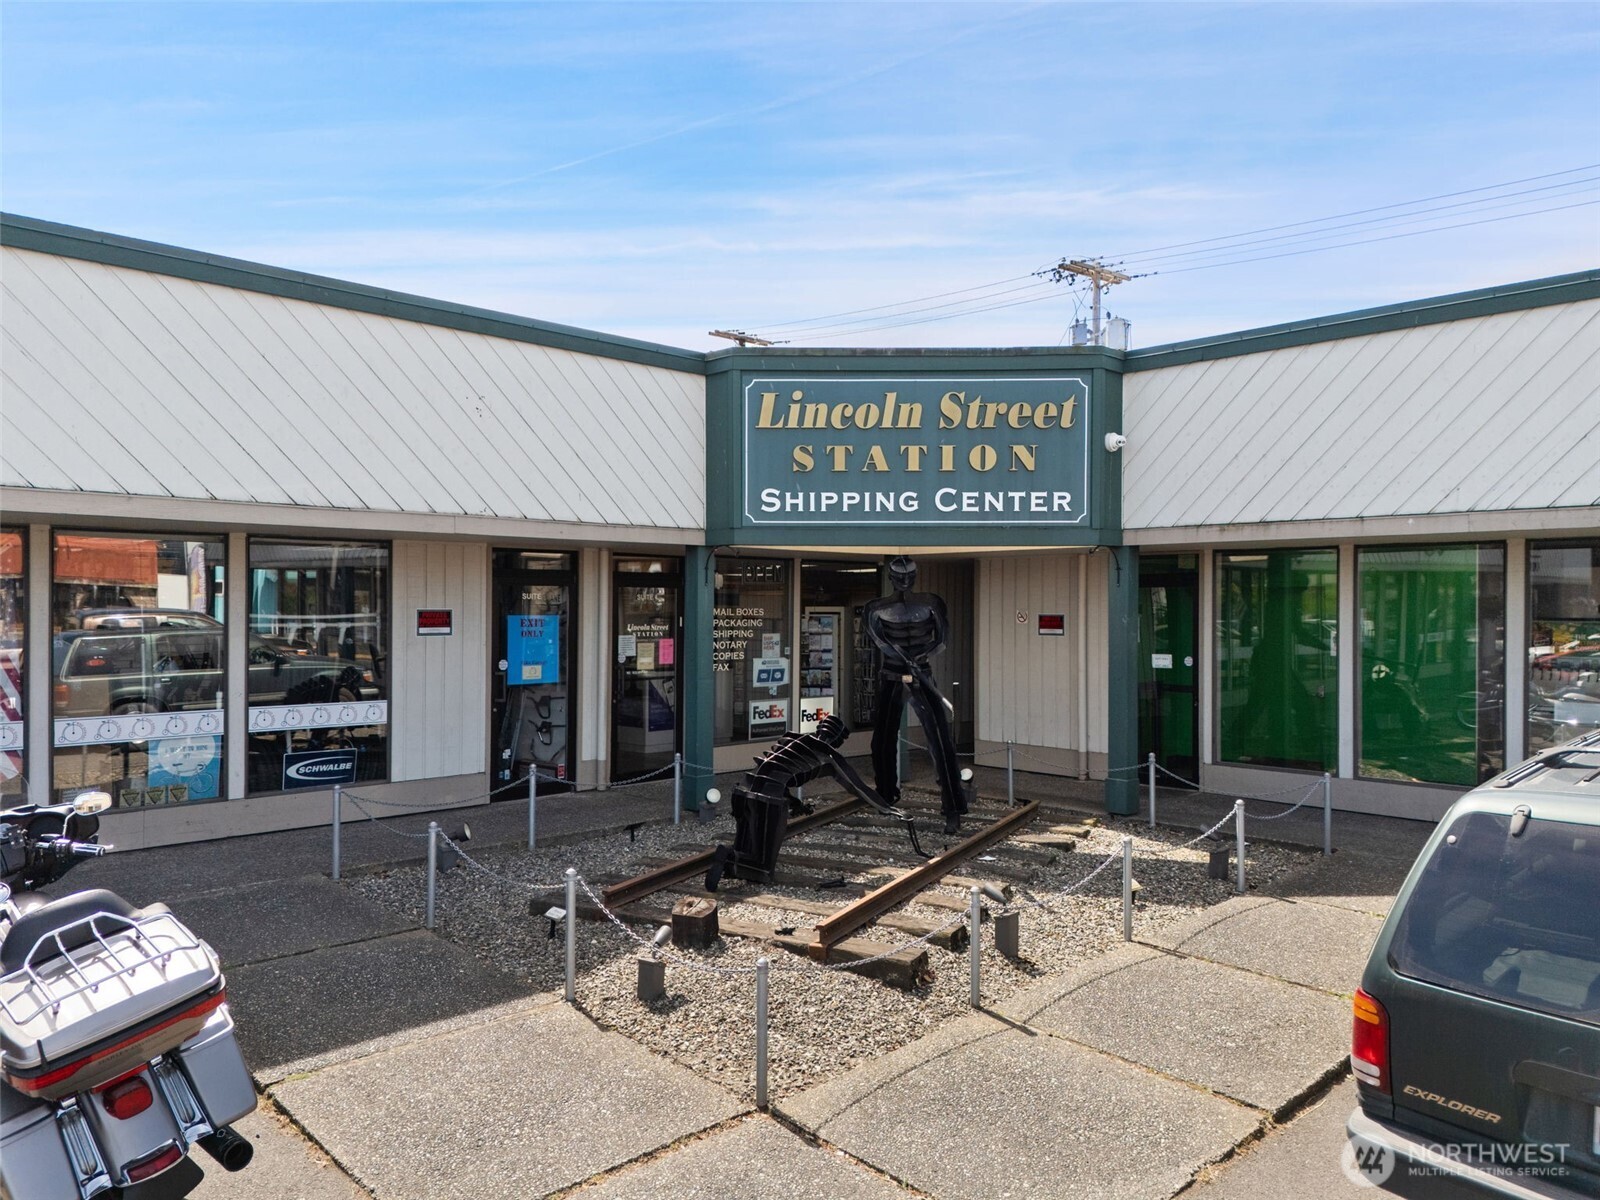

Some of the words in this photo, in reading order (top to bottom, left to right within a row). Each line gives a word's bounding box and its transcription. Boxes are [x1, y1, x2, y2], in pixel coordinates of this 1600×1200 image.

[755, 389, 923, 430] Lincoln
[938, 390, 1078, 430] Street
[792, 444, 1039, 473] STATION
[760, 488, 919, 513] SHIPPING
[934, 488, 1073, 513] CENTER
[744, 565, 782, 582] OPEN
[522, 592, 542, 600] SUITE
[712, 608, 734, 616] MAIL
[736, 608, 764, 616] BOXES
[520, 618, 545, 628] EXIT
[627, 623, 650, 631] Lincoln
[651, 623, 669, 631] Street
[712, 619, 763, 627] PACKAGING
[521, 630, 545, 638] ONLY
[712, 630, 754, 638] SHIPPING
[712, 641, 748, 650] NOTARY
[712, 652, 745, 661] COPIES
[712, 663, 730, 672] FAX
[753, 704, 785, 720] FedEx
[298, 762, 353, 774] SCHWALBE
[1402, 1084, 1502, 1124] EXPLORER
